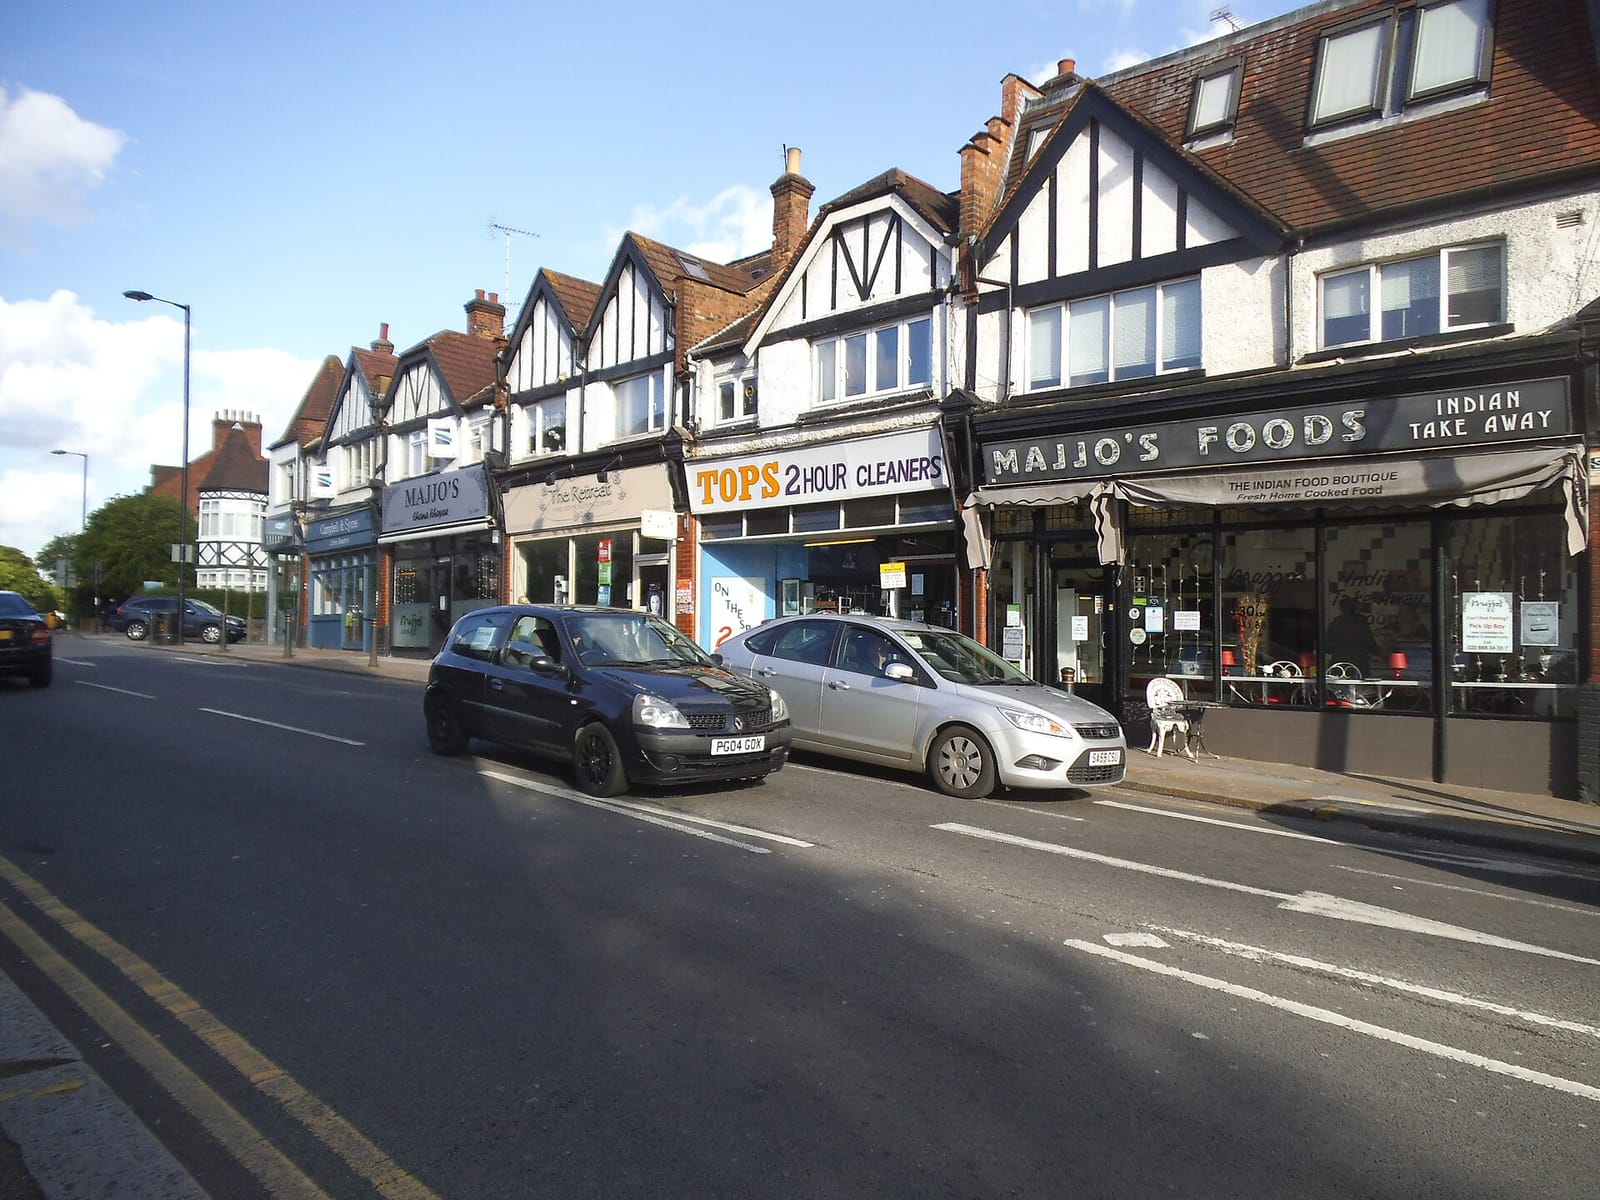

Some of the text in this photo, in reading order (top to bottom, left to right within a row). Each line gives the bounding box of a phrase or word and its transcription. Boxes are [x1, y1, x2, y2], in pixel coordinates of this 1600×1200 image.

[1436, 390, 1520, 416] INDIAN
[1409, 409, 1552, 440] TAKE AWAY
[992, 409, 1367, 476] MAJJO'S FOODS
[696, 455, 942, 505] TOPS 2 HOUR CLEANERS
[1229, 471, 1398, 491] THE INDIAN FOOD BOUTIQUE
[404, 478, 459, 508] MAJJO'S
[549, 484, 612, 504] The Retreat
[1236, 485, 1383, 501] Fresh Home Cooked Food
[714, 582, 729, 596] ON
[725, 600, 743, 619] THE
